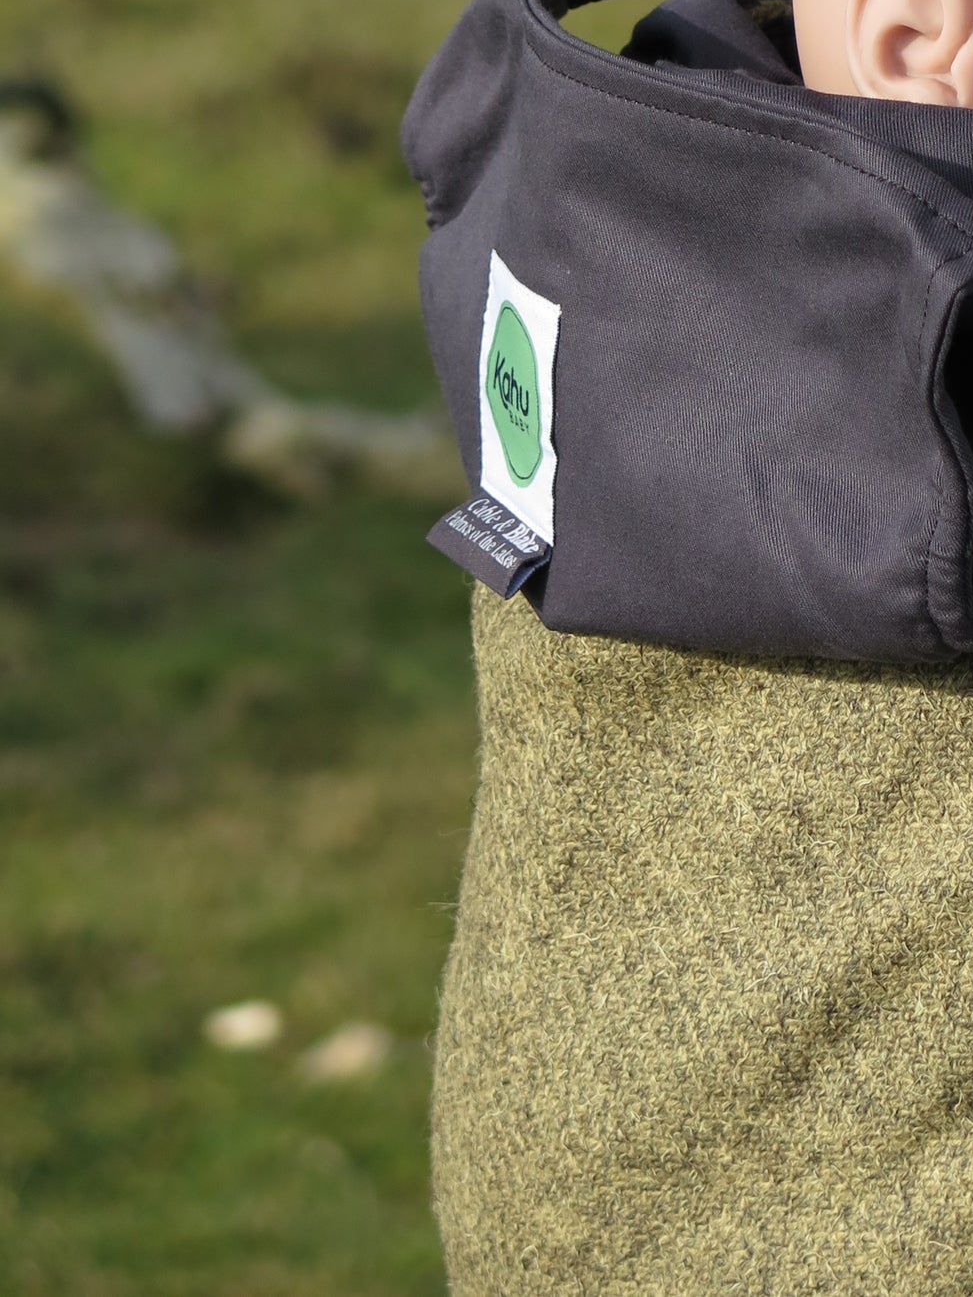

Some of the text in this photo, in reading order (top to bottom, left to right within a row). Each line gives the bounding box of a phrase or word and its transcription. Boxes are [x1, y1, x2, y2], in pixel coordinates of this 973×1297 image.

[493, 351, 529, 417] Kahu
[445, 510, 475, 536] Fabrics
[478, 535, 498, 552] the
[490, 543, 517, 569] Lakes
[467, 498, 540, 553] Cable & Blake
